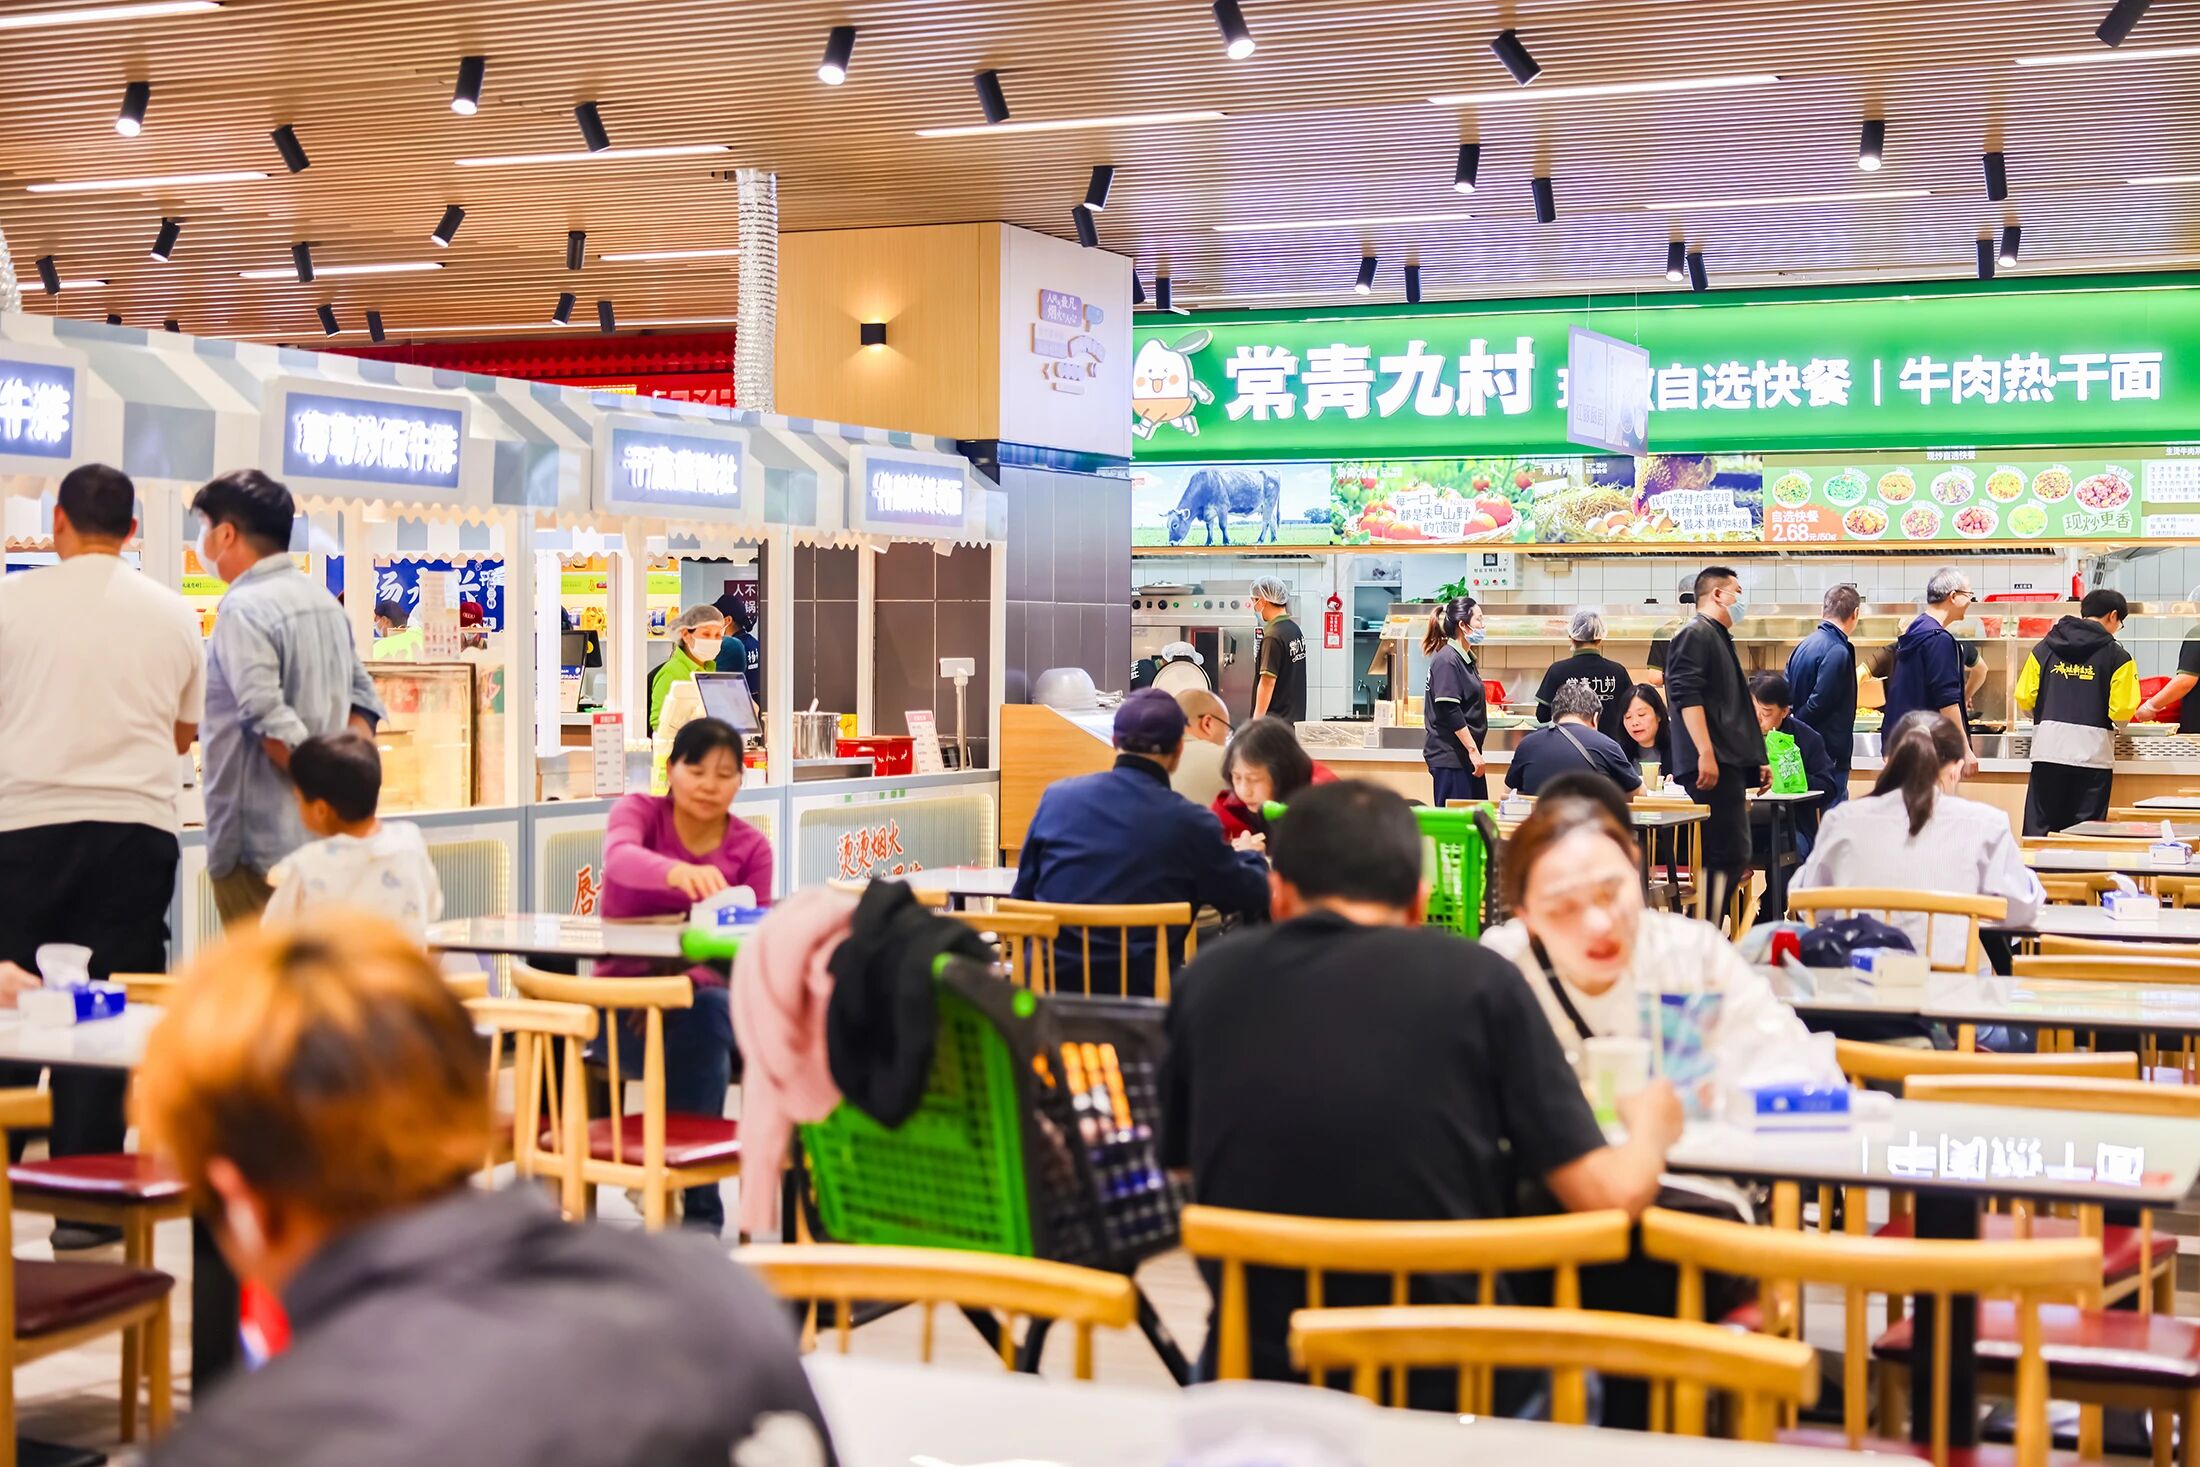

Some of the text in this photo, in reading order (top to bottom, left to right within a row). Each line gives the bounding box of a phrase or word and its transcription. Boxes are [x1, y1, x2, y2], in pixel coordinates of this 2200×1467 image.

[1225, 336, 1536, 421] 常青九村
[1557, 358, 1852, 410] 自选快餐
[1899, 351, 2164, 404] 牛肉热干面
[1400, 504, 1472, 522] 都是来自山野
[1671, 504, 1730, 517] 食物最新鲜
[1771, 510, 1819, 523] 自选快餐
[1683, 519, 1749, 531] 最本真的味道
[2065, 511, 2132, 532] 现炒更香
[733, 584, 758, 597] 人不
[573, 866, 601, 916] 唇
